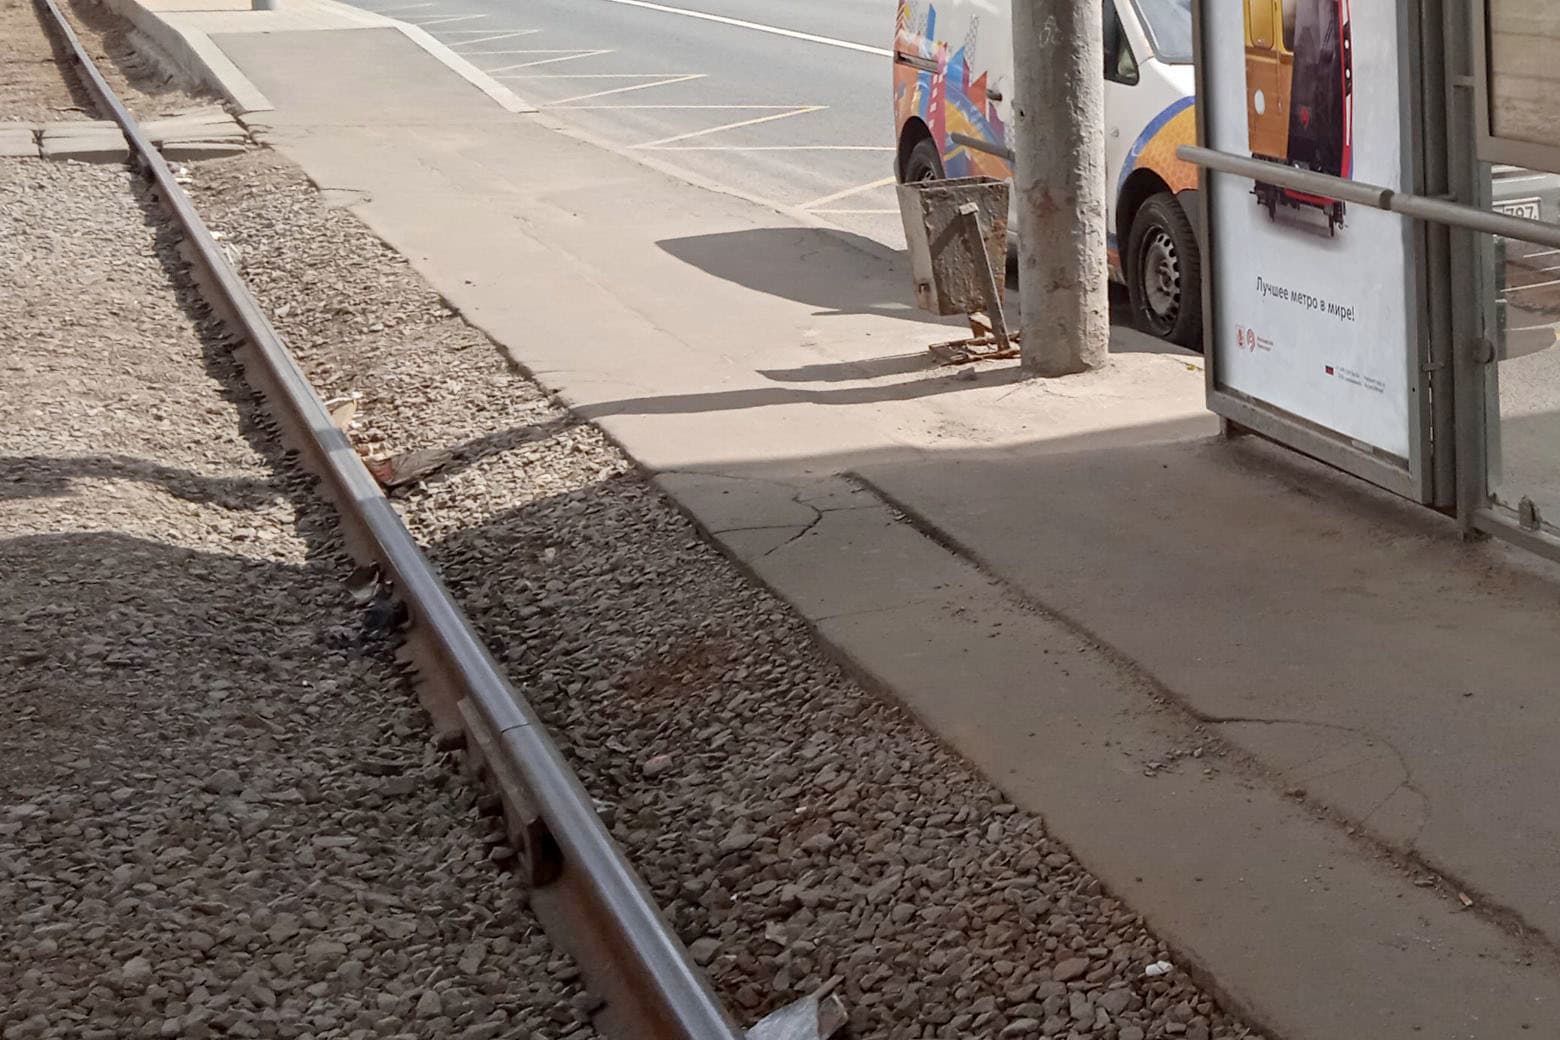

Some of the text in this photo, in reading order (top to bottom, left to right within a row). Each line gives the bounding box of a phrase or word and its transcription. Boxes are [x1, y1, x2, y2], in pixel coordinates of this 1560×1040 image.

[1256, 276, 1355, 322] Лучшее метро в мире!
